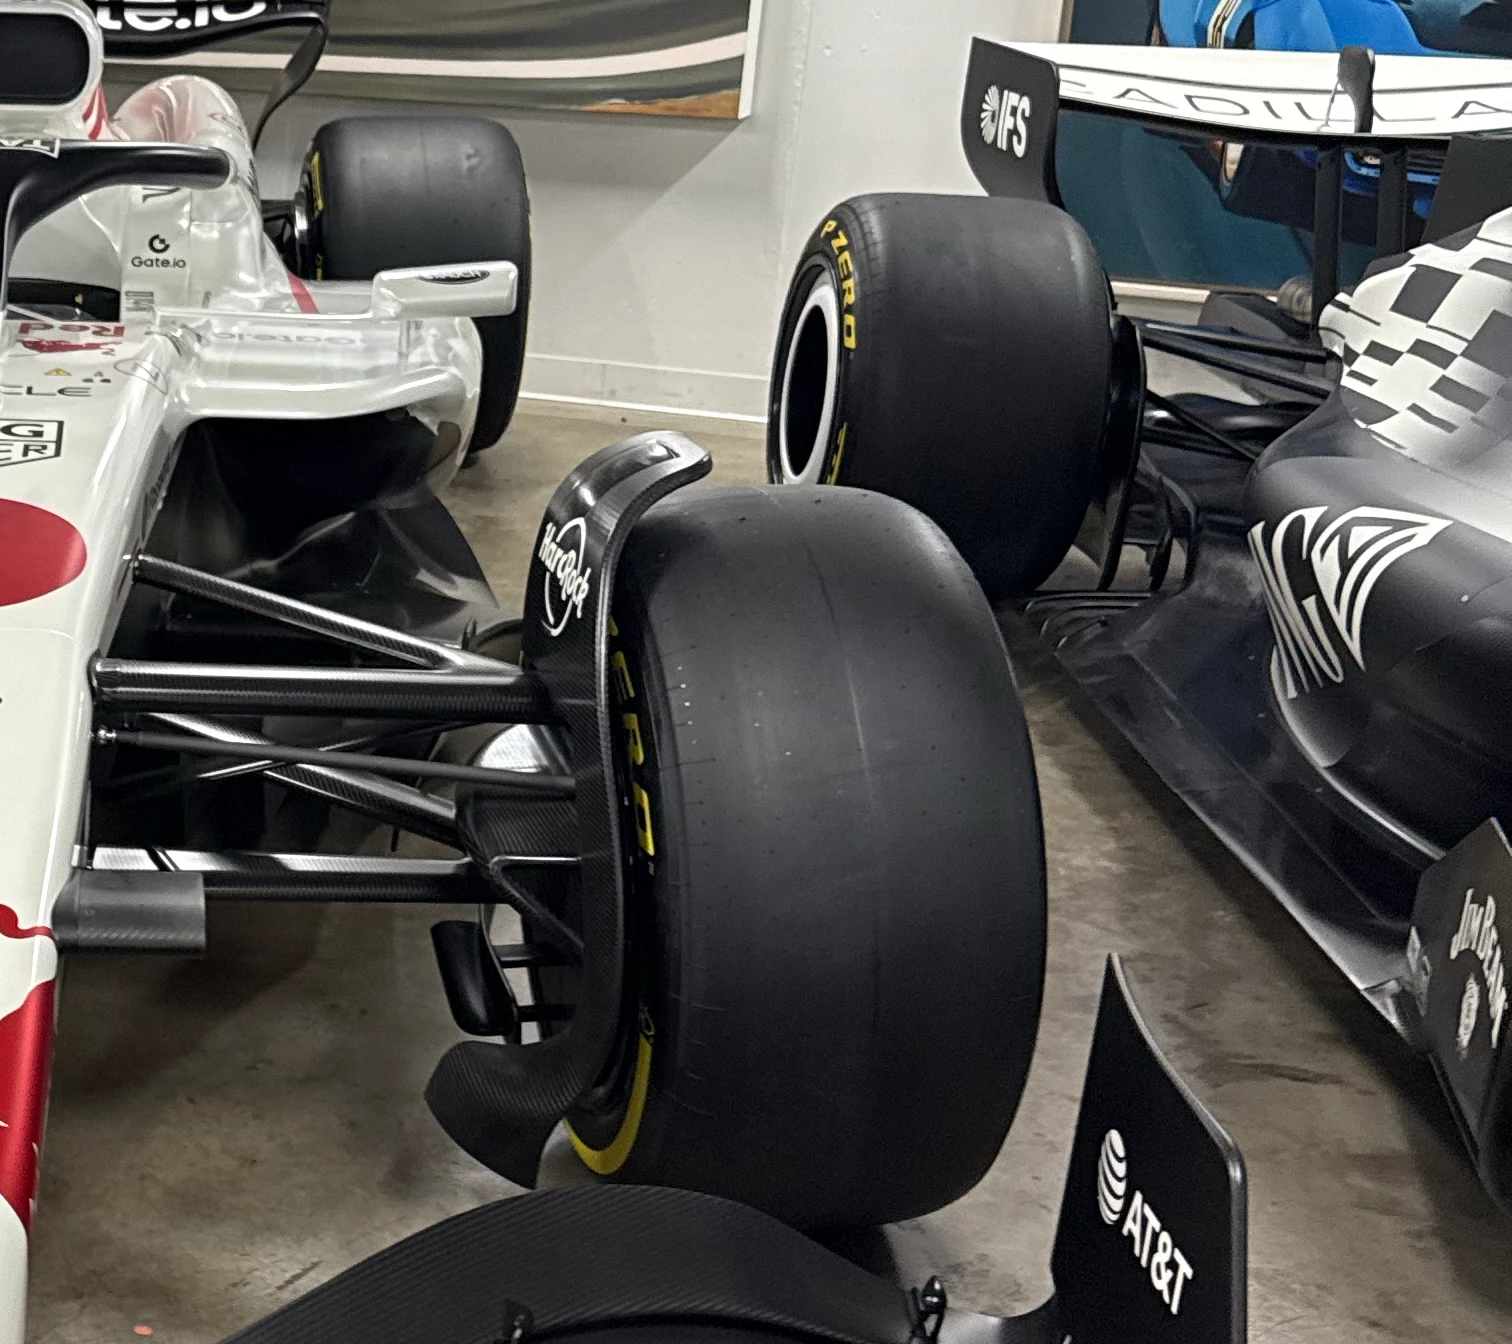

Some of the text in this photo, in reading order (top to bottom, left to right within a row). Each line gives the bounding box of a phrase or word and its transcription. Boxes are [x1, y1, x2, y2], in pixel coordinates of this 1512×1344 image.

[1001, 88, 1031, 158] IFS
[131, 255, 187, 269] Gate.io
[830, 229, 857, 350] ZERO
[1121, 1189, 1194, 1316] AT&T
